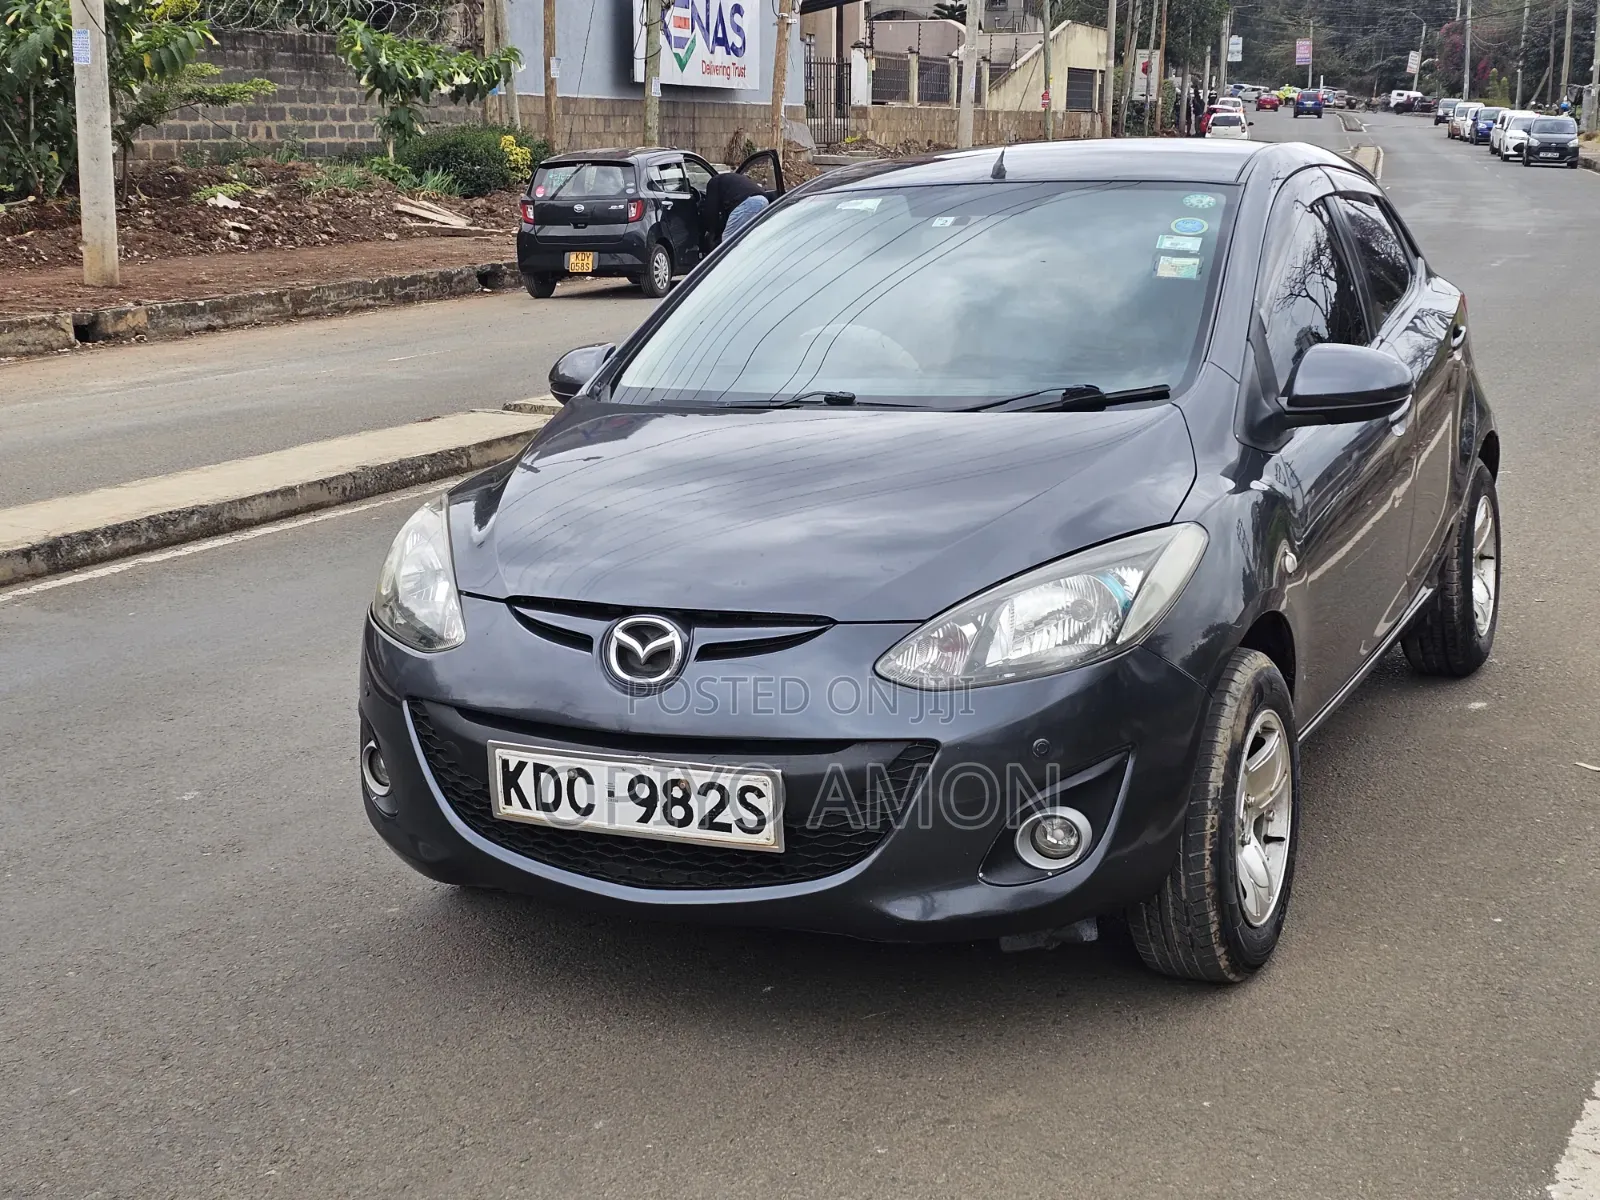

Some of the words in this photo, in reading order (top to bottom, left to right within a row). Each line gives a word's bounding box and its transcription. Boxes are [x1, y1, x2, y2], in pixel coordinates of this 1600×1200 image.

[701, 60, 731, 80] Delivering
[732, 62, 746, 78] Trust
[575, 252, 591, 261] KDY
[501, 758, 596, 818] KDC
[627, 774, 767, 835] 982S
